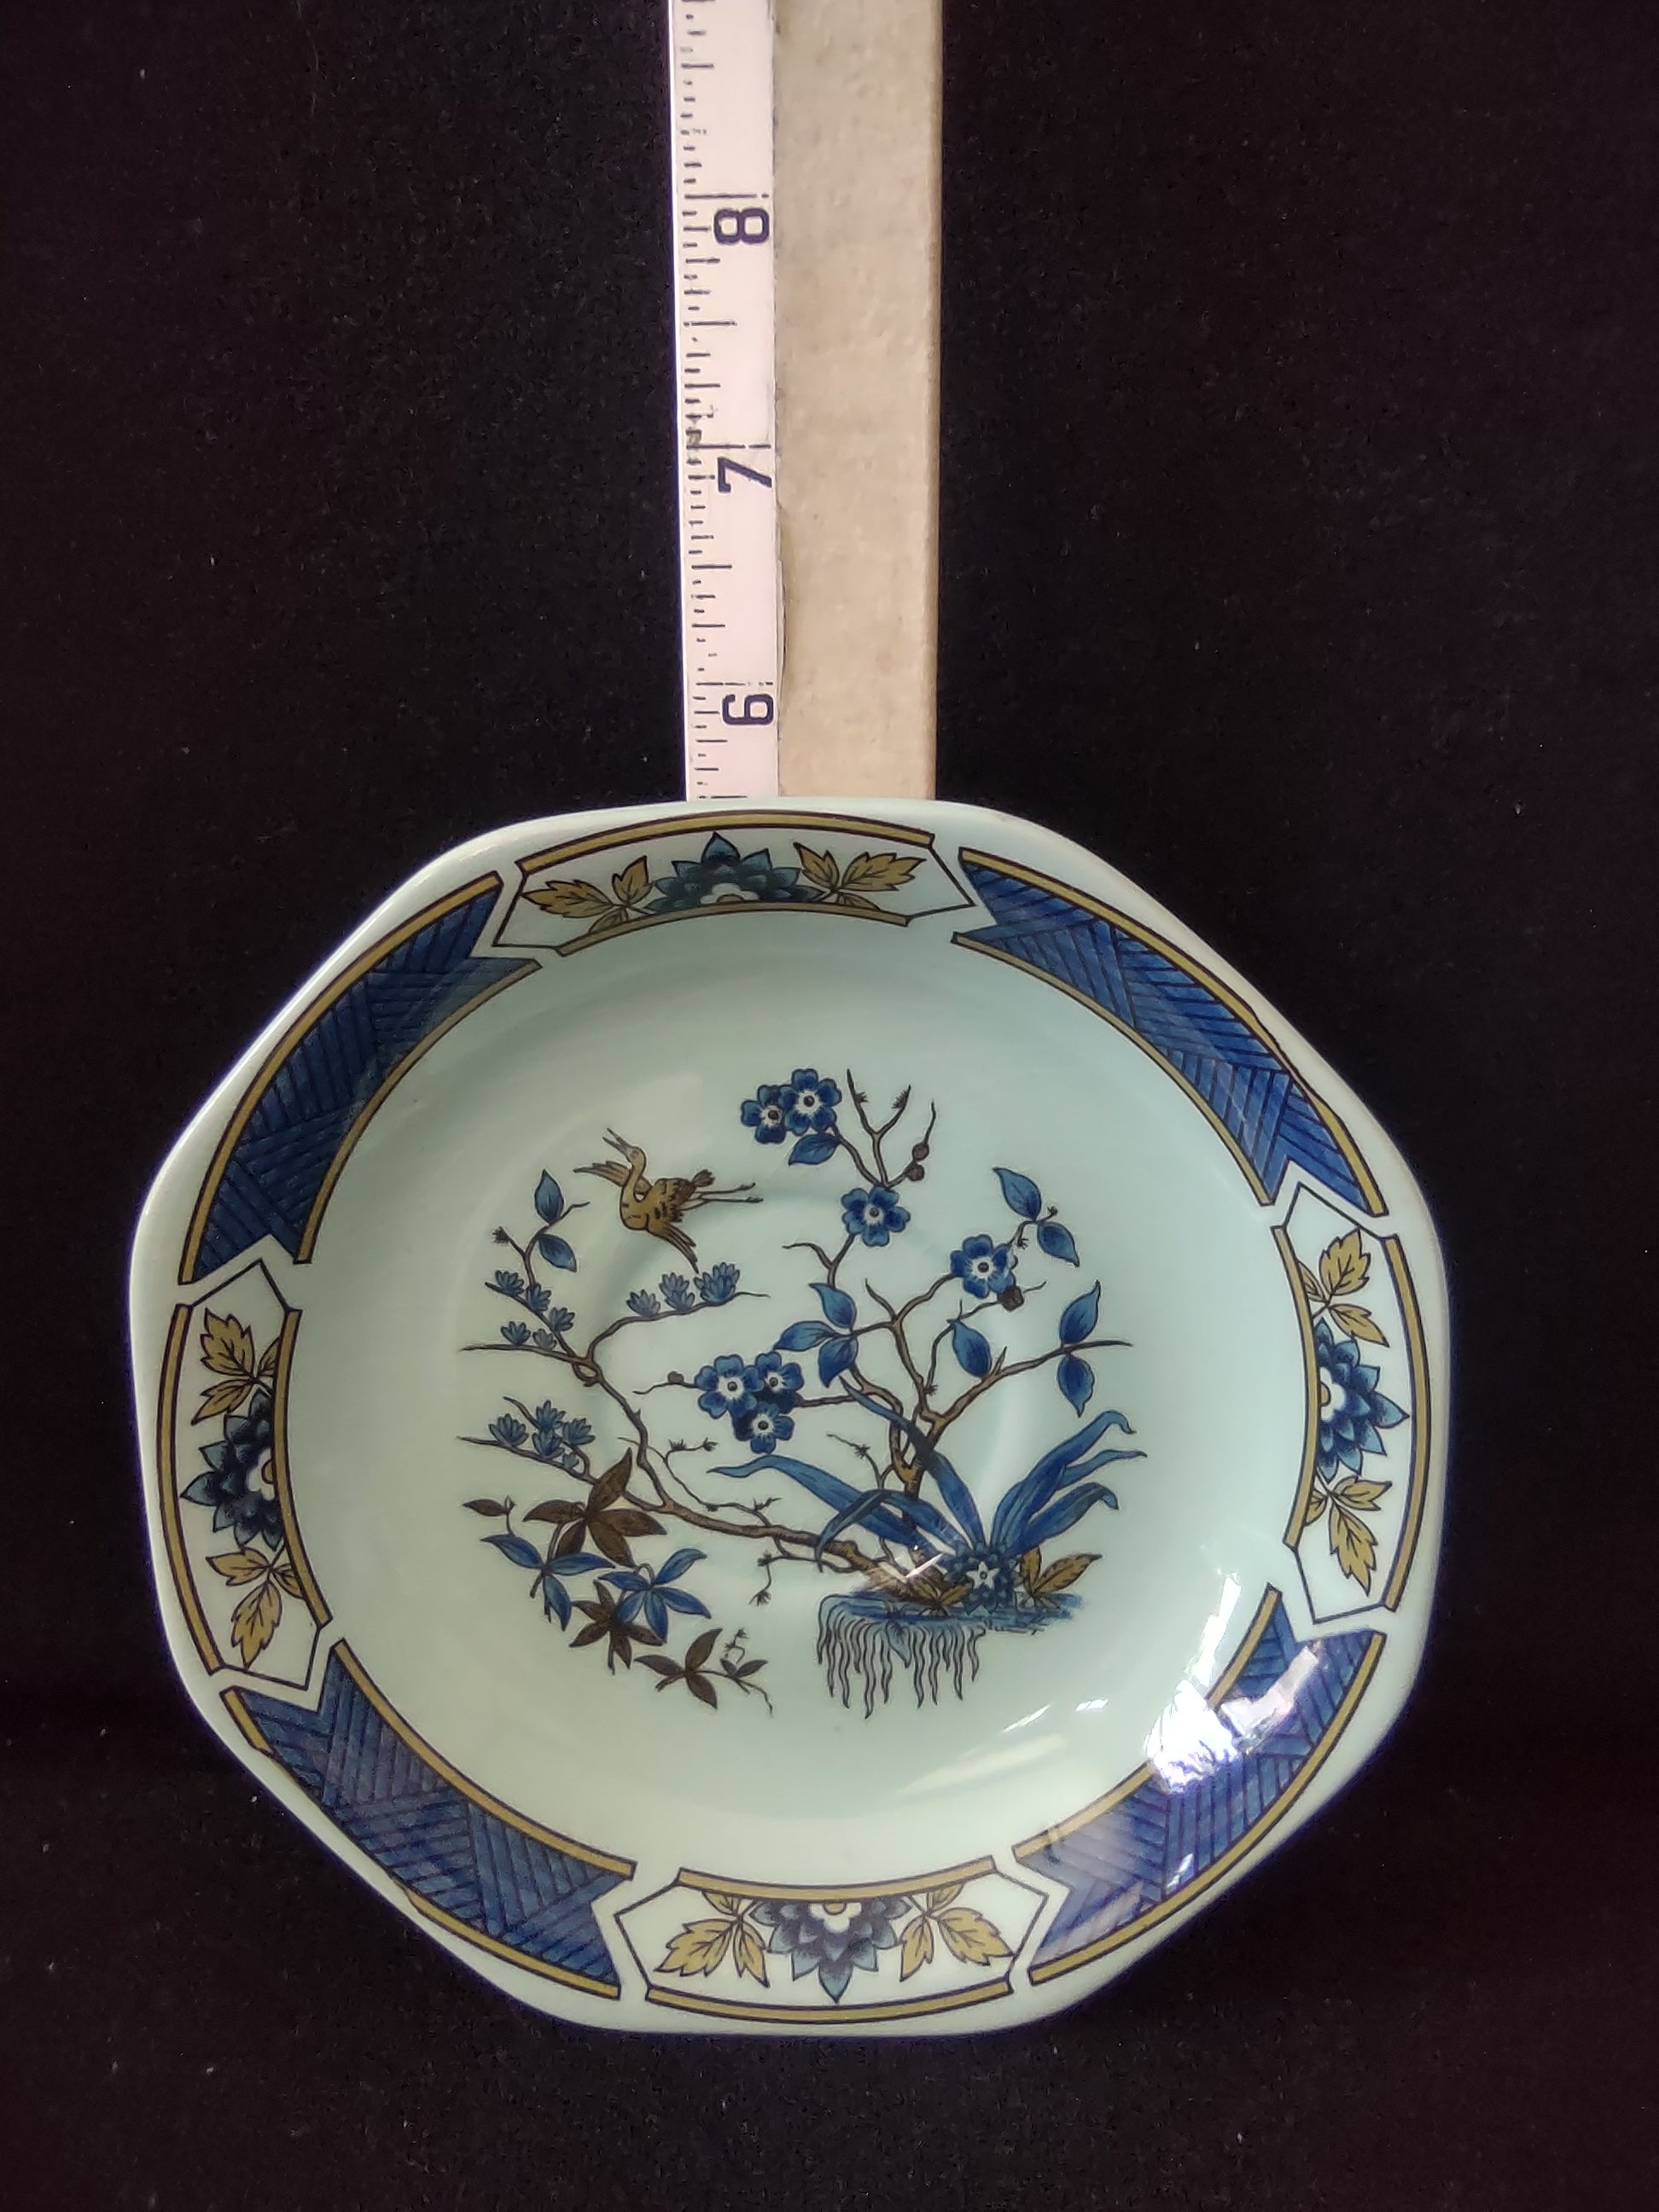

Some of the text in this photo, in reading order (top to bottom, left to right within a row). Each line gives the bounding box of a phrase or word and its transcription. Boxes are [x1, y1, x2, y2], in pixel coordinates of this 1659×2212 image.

[713, 207, 770, 245] 8
[717, 457, 772, 493] 7
[722, 693, 774, 725] 6
